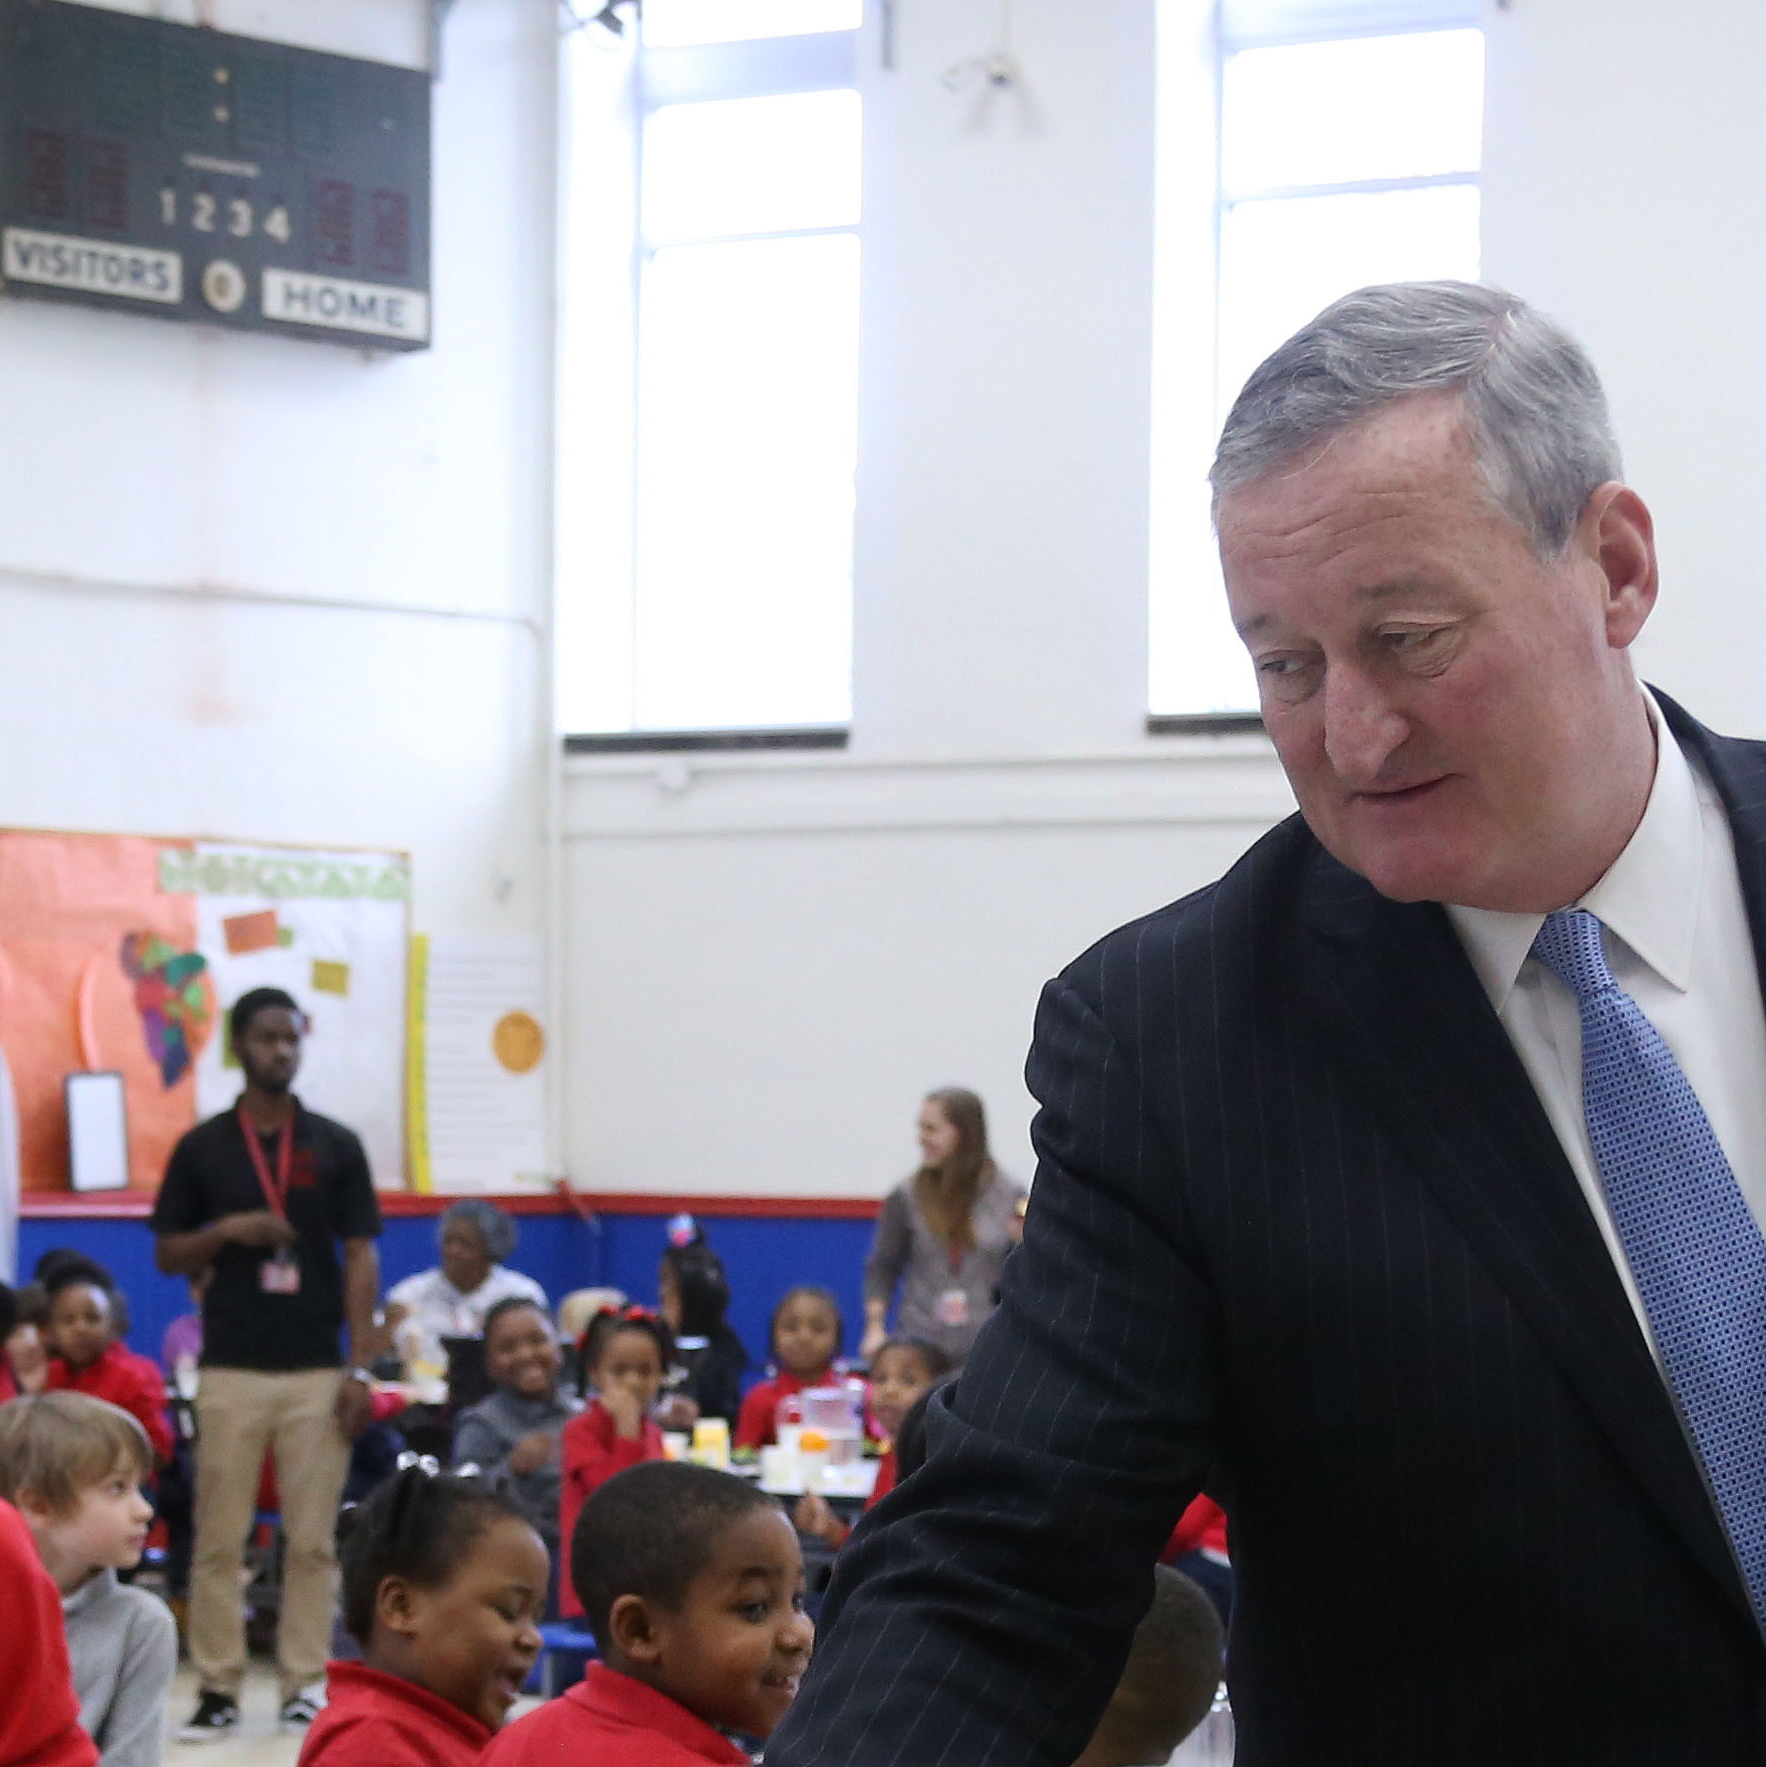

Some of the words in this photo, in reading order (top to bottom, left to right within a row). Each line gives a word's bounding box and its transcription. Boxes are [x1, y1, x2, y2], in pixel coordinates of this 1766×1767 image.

[161, 189, 177, 225] 1
[192, 192, 216, 232] 2
[227, 199, 253, 238] 3
[264, 206, 290, 243] 4
[13, 241, 169, 291] VISITORS
[283, 280, 404, 327] HOME
